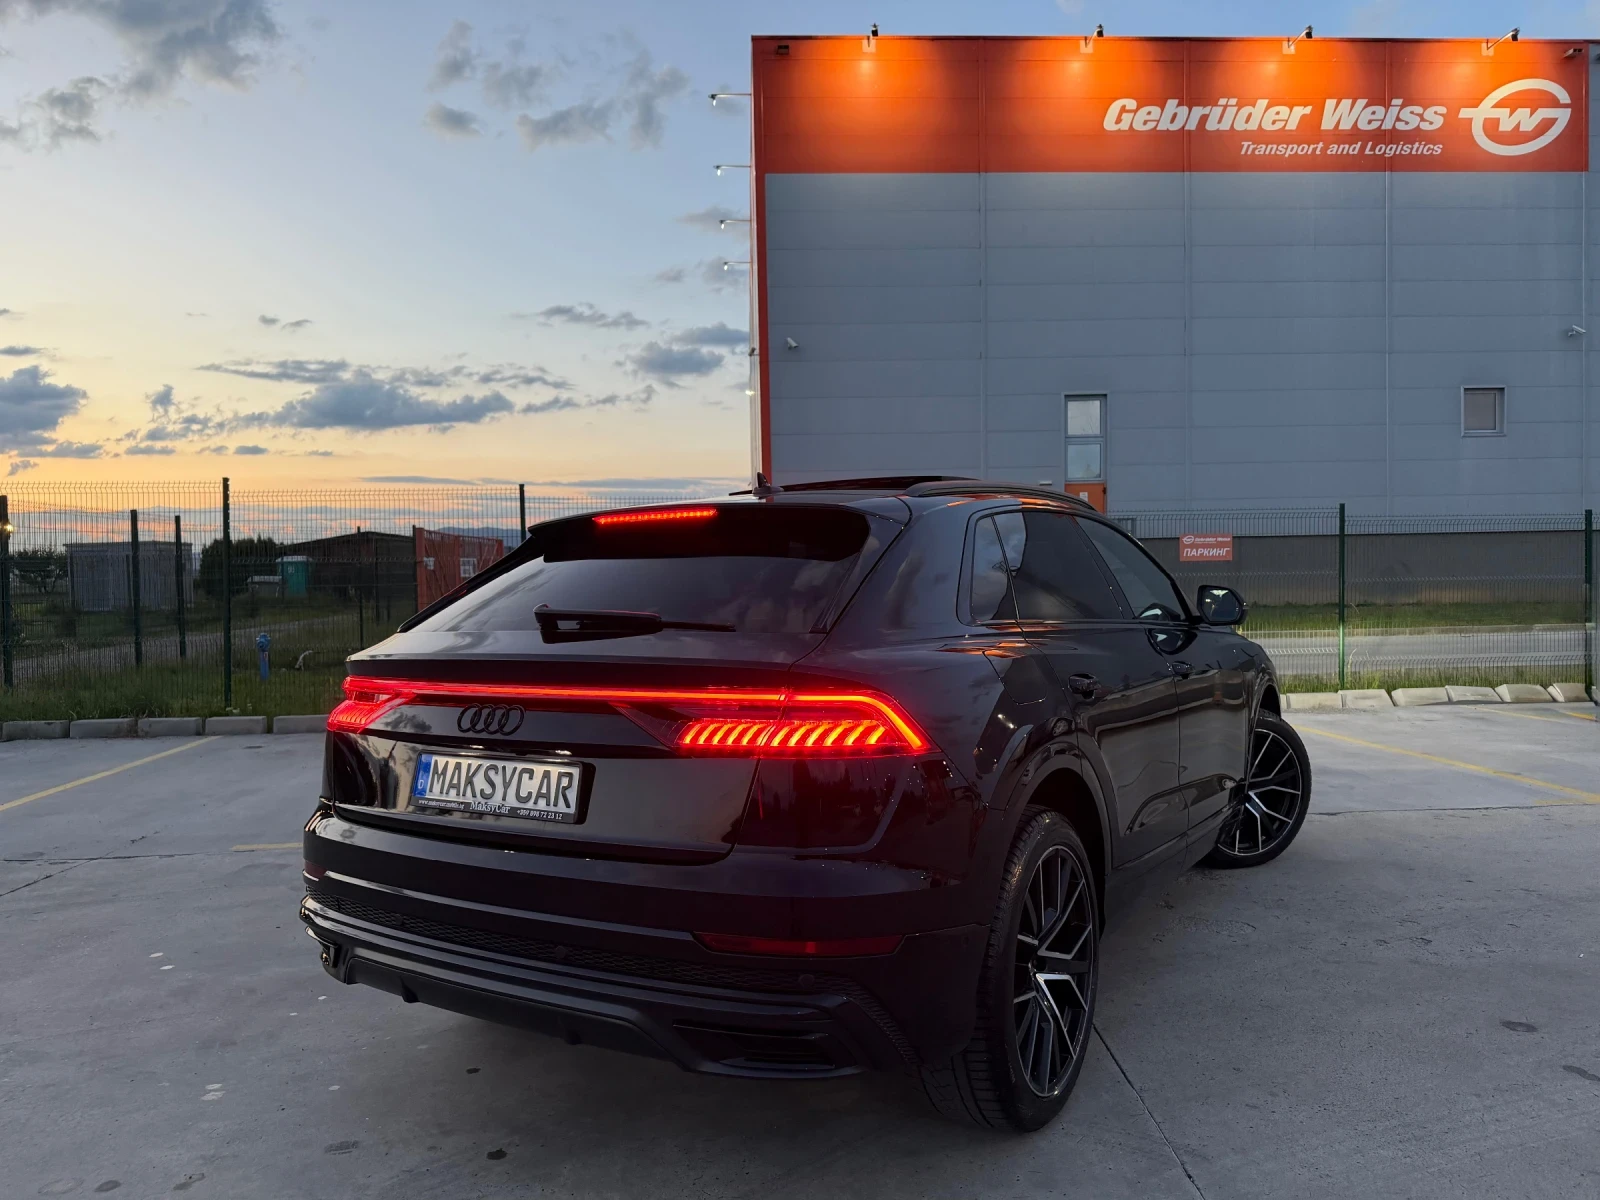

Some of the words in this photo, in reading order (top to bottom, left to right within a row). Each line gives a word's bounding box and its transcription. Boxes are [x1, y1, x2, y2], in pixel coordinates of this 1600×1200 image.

[1103, 98, 1312, 132] Gebrüder
[1320, 98, 1448, 131] Weiss
[1240, 141, 1324, 157] Transport
[1327, 141, 1361, 155] and
[1364, 141, 1443, 157] Logistics
[1183, 547, 1230, 557] ПАРКИНГ
[428, 759, 574, 809] MAKSYCAR
[470, 801, 511, 814] MaksyCar
